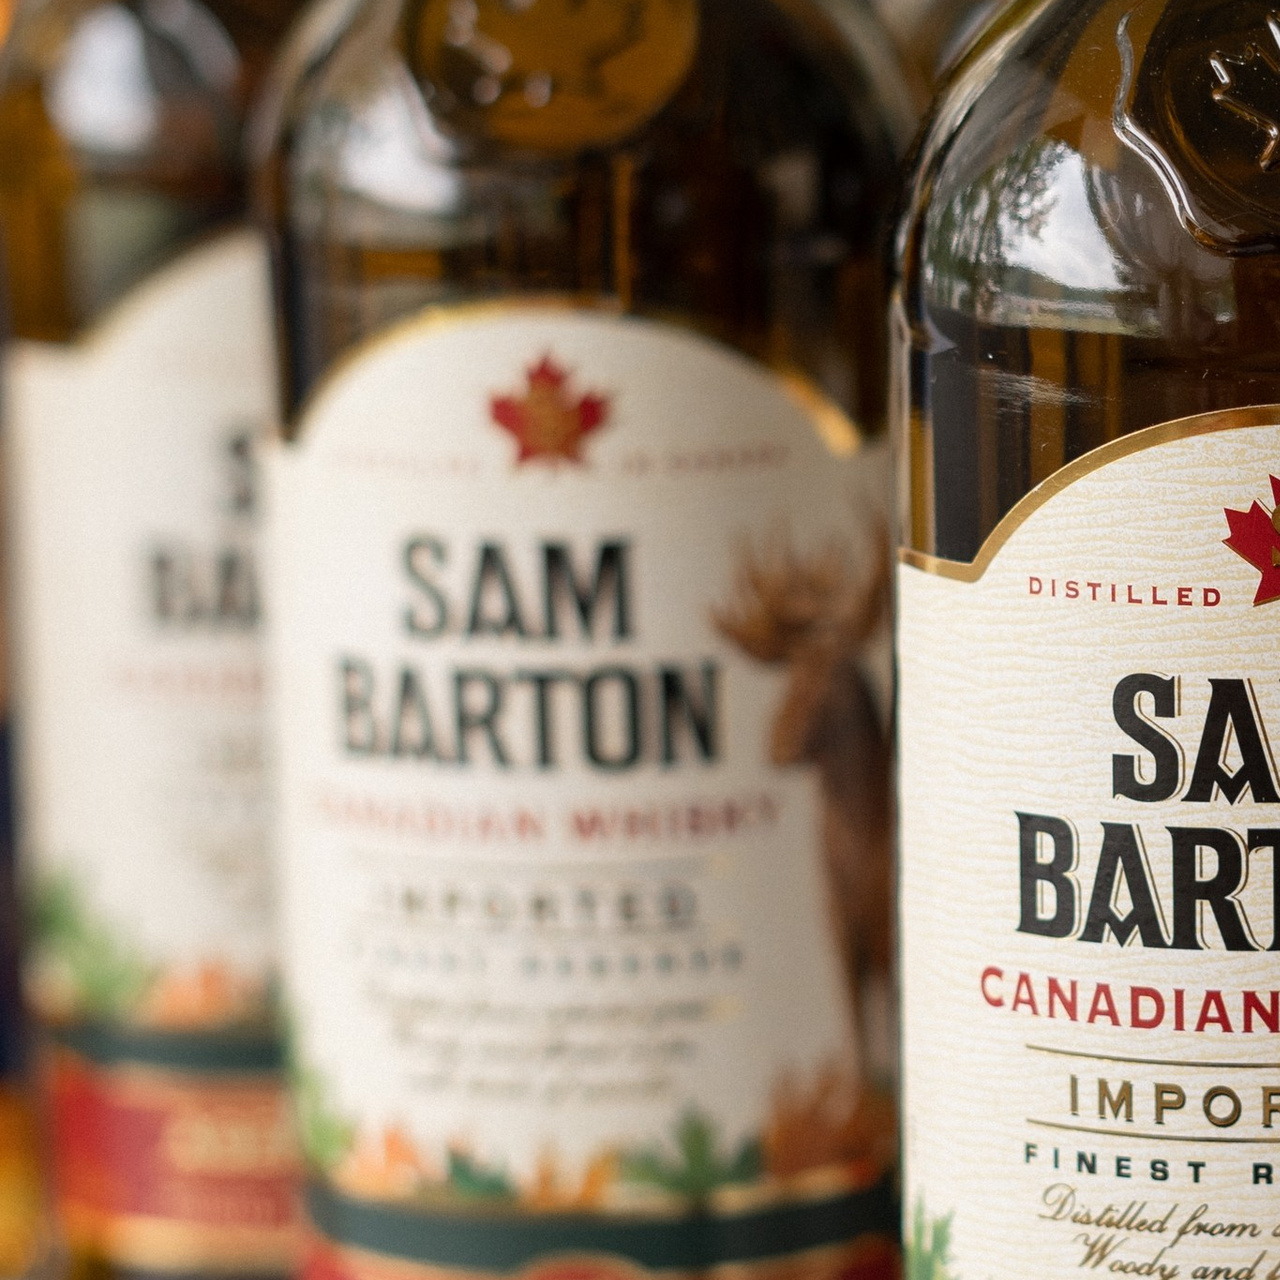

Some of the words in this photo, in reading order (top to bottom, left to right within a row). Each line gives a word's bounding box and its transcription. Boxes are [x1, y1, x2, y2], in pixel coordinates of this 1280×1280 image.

[401, 532, 636, 645] SAM
[1028, 576, 1221, 607] DISTILLED
[336, 651, 724, 771] BARTON
[980, 967, 1280, 1033] CANADIAN
[1025, 1142, 1206, 1183] FINEST
[1038, 1183, 1179, 1234] Distilled
[1167, 1203, 1262, 1249] from
